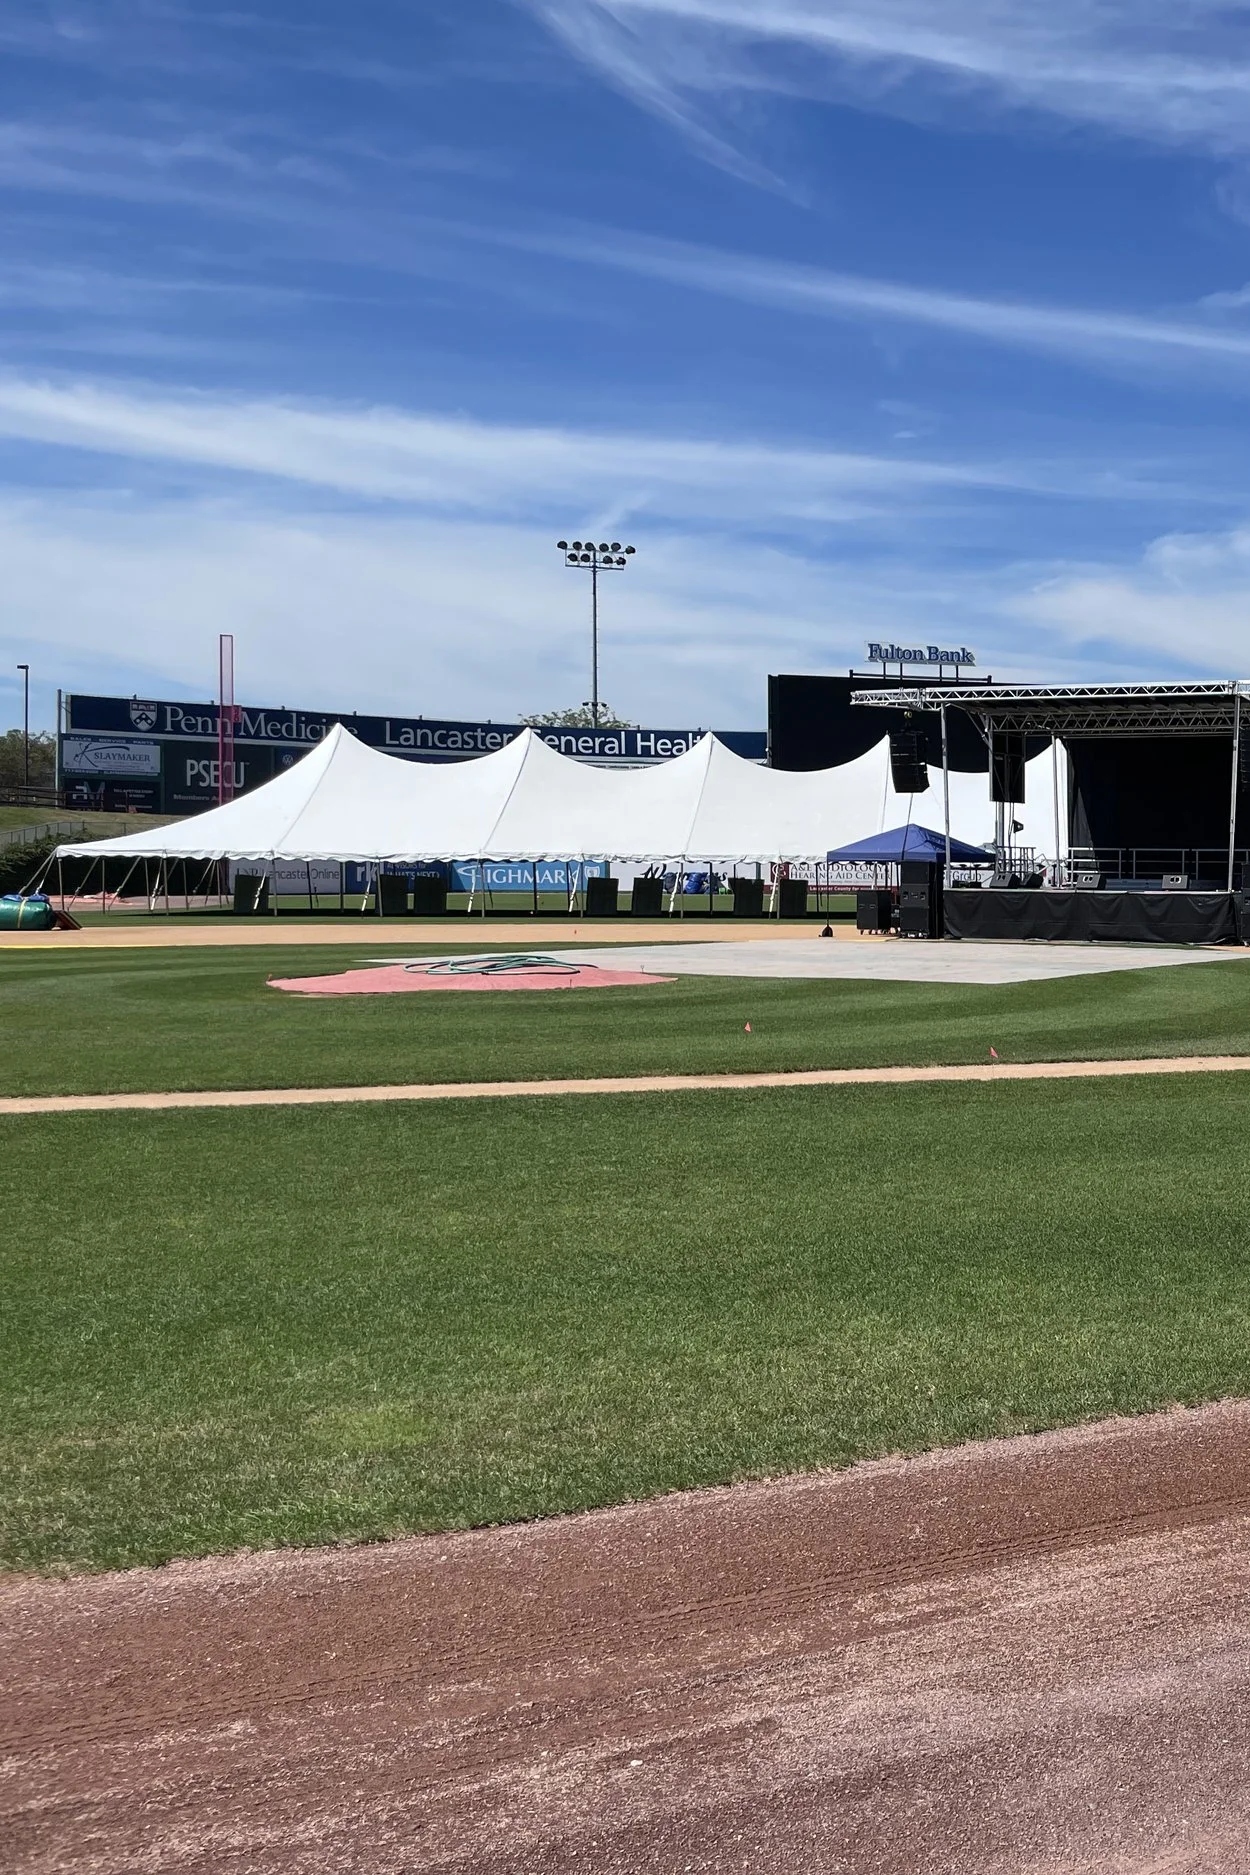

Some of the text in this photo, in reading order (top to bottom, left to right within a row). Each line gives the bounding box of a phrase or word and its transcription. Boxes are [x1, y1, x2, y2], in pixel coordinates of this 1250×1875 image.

[867, 643, 973, 663] Fulton Bank
[164, 705, 359, 741] Penn Medicie
[385, 720, 702, 757] Lancaster eneral Healt
[94, 752, 151, 762] SLAYMAKER
[186, 759, 245, 788] PSECU
[790, 872, 832, 880] HEARNG
[837, 872, 853, 880] AID
